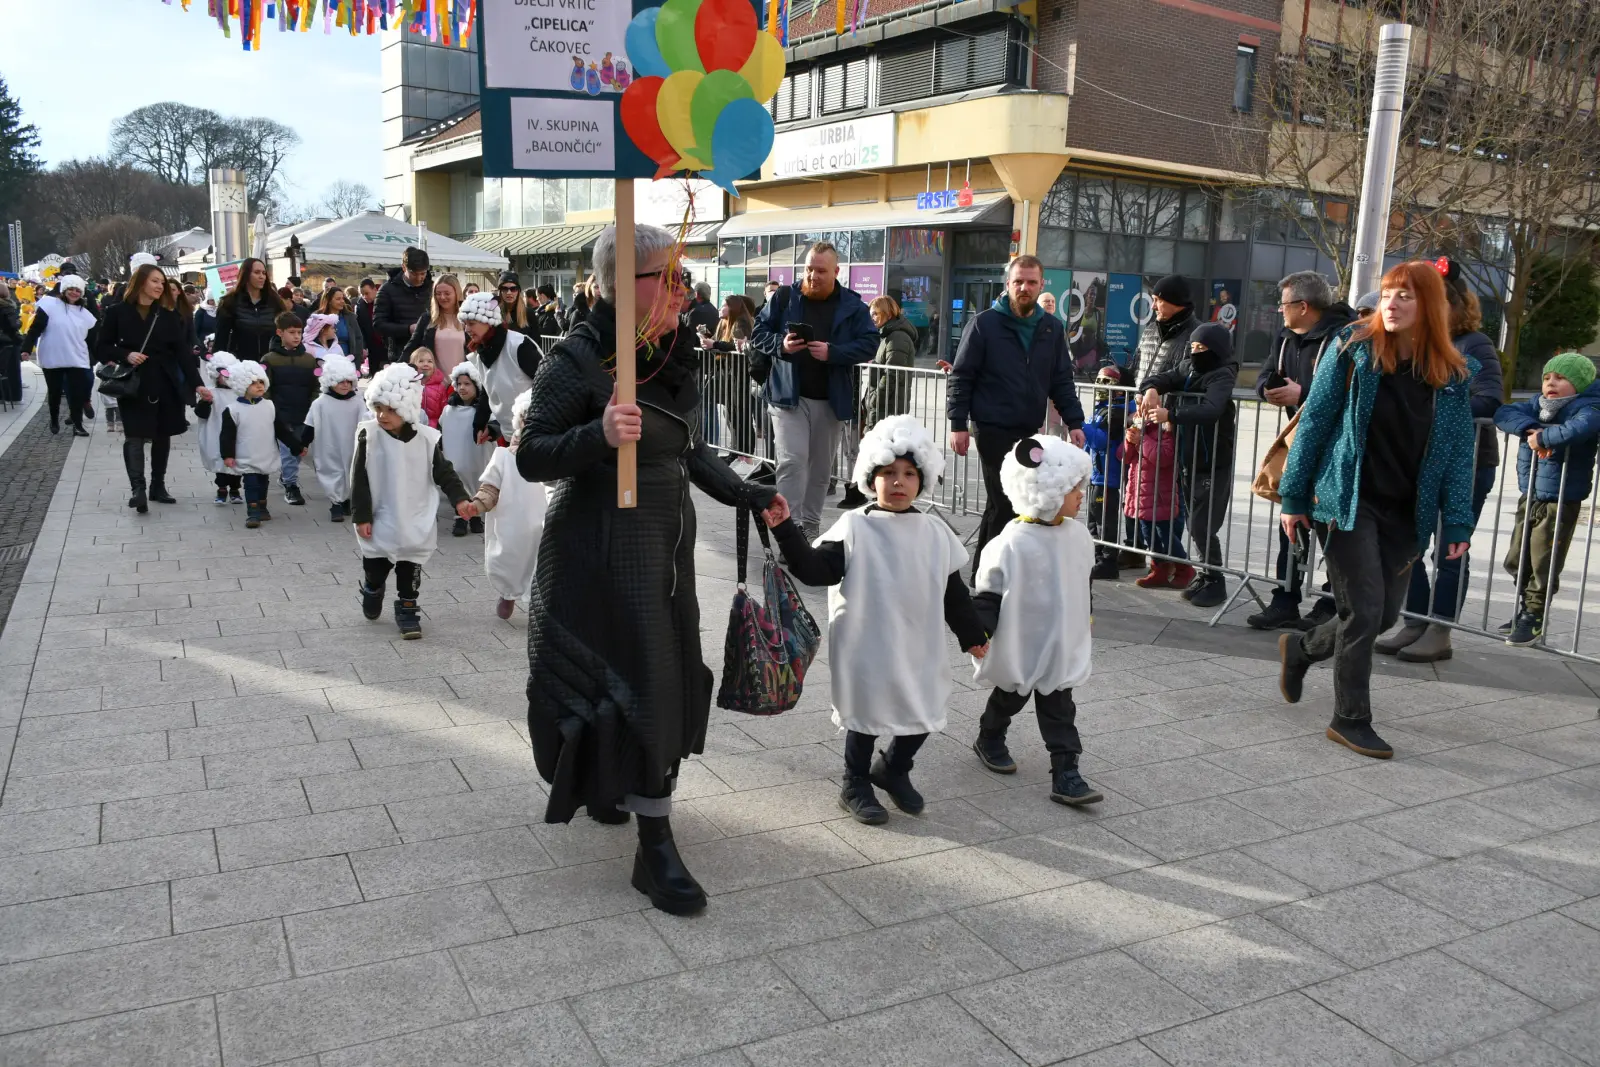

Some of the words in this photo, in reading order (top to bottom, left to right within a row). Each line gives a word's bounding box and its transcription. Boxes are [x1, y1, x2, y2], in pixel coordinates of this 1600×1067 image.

[524, 16, 595, 33] „CIPELICA“
[529, 36, 591, 55] ČAKOVEC
[527, 118, 543, 131] IV.
[546, 119, 600, 133] SKUPINA
[819, 124, 856, 146] URBIA
[525, 138, 602, 154] „BALONČIĆI“
[784, 154, 808, 174] urbi
[811, 153, 825, 171] et
[829, 148, 856, 169] orbi
[860, 144, 880, 165] 25
[917, 189, 958, 210] ERSTE
